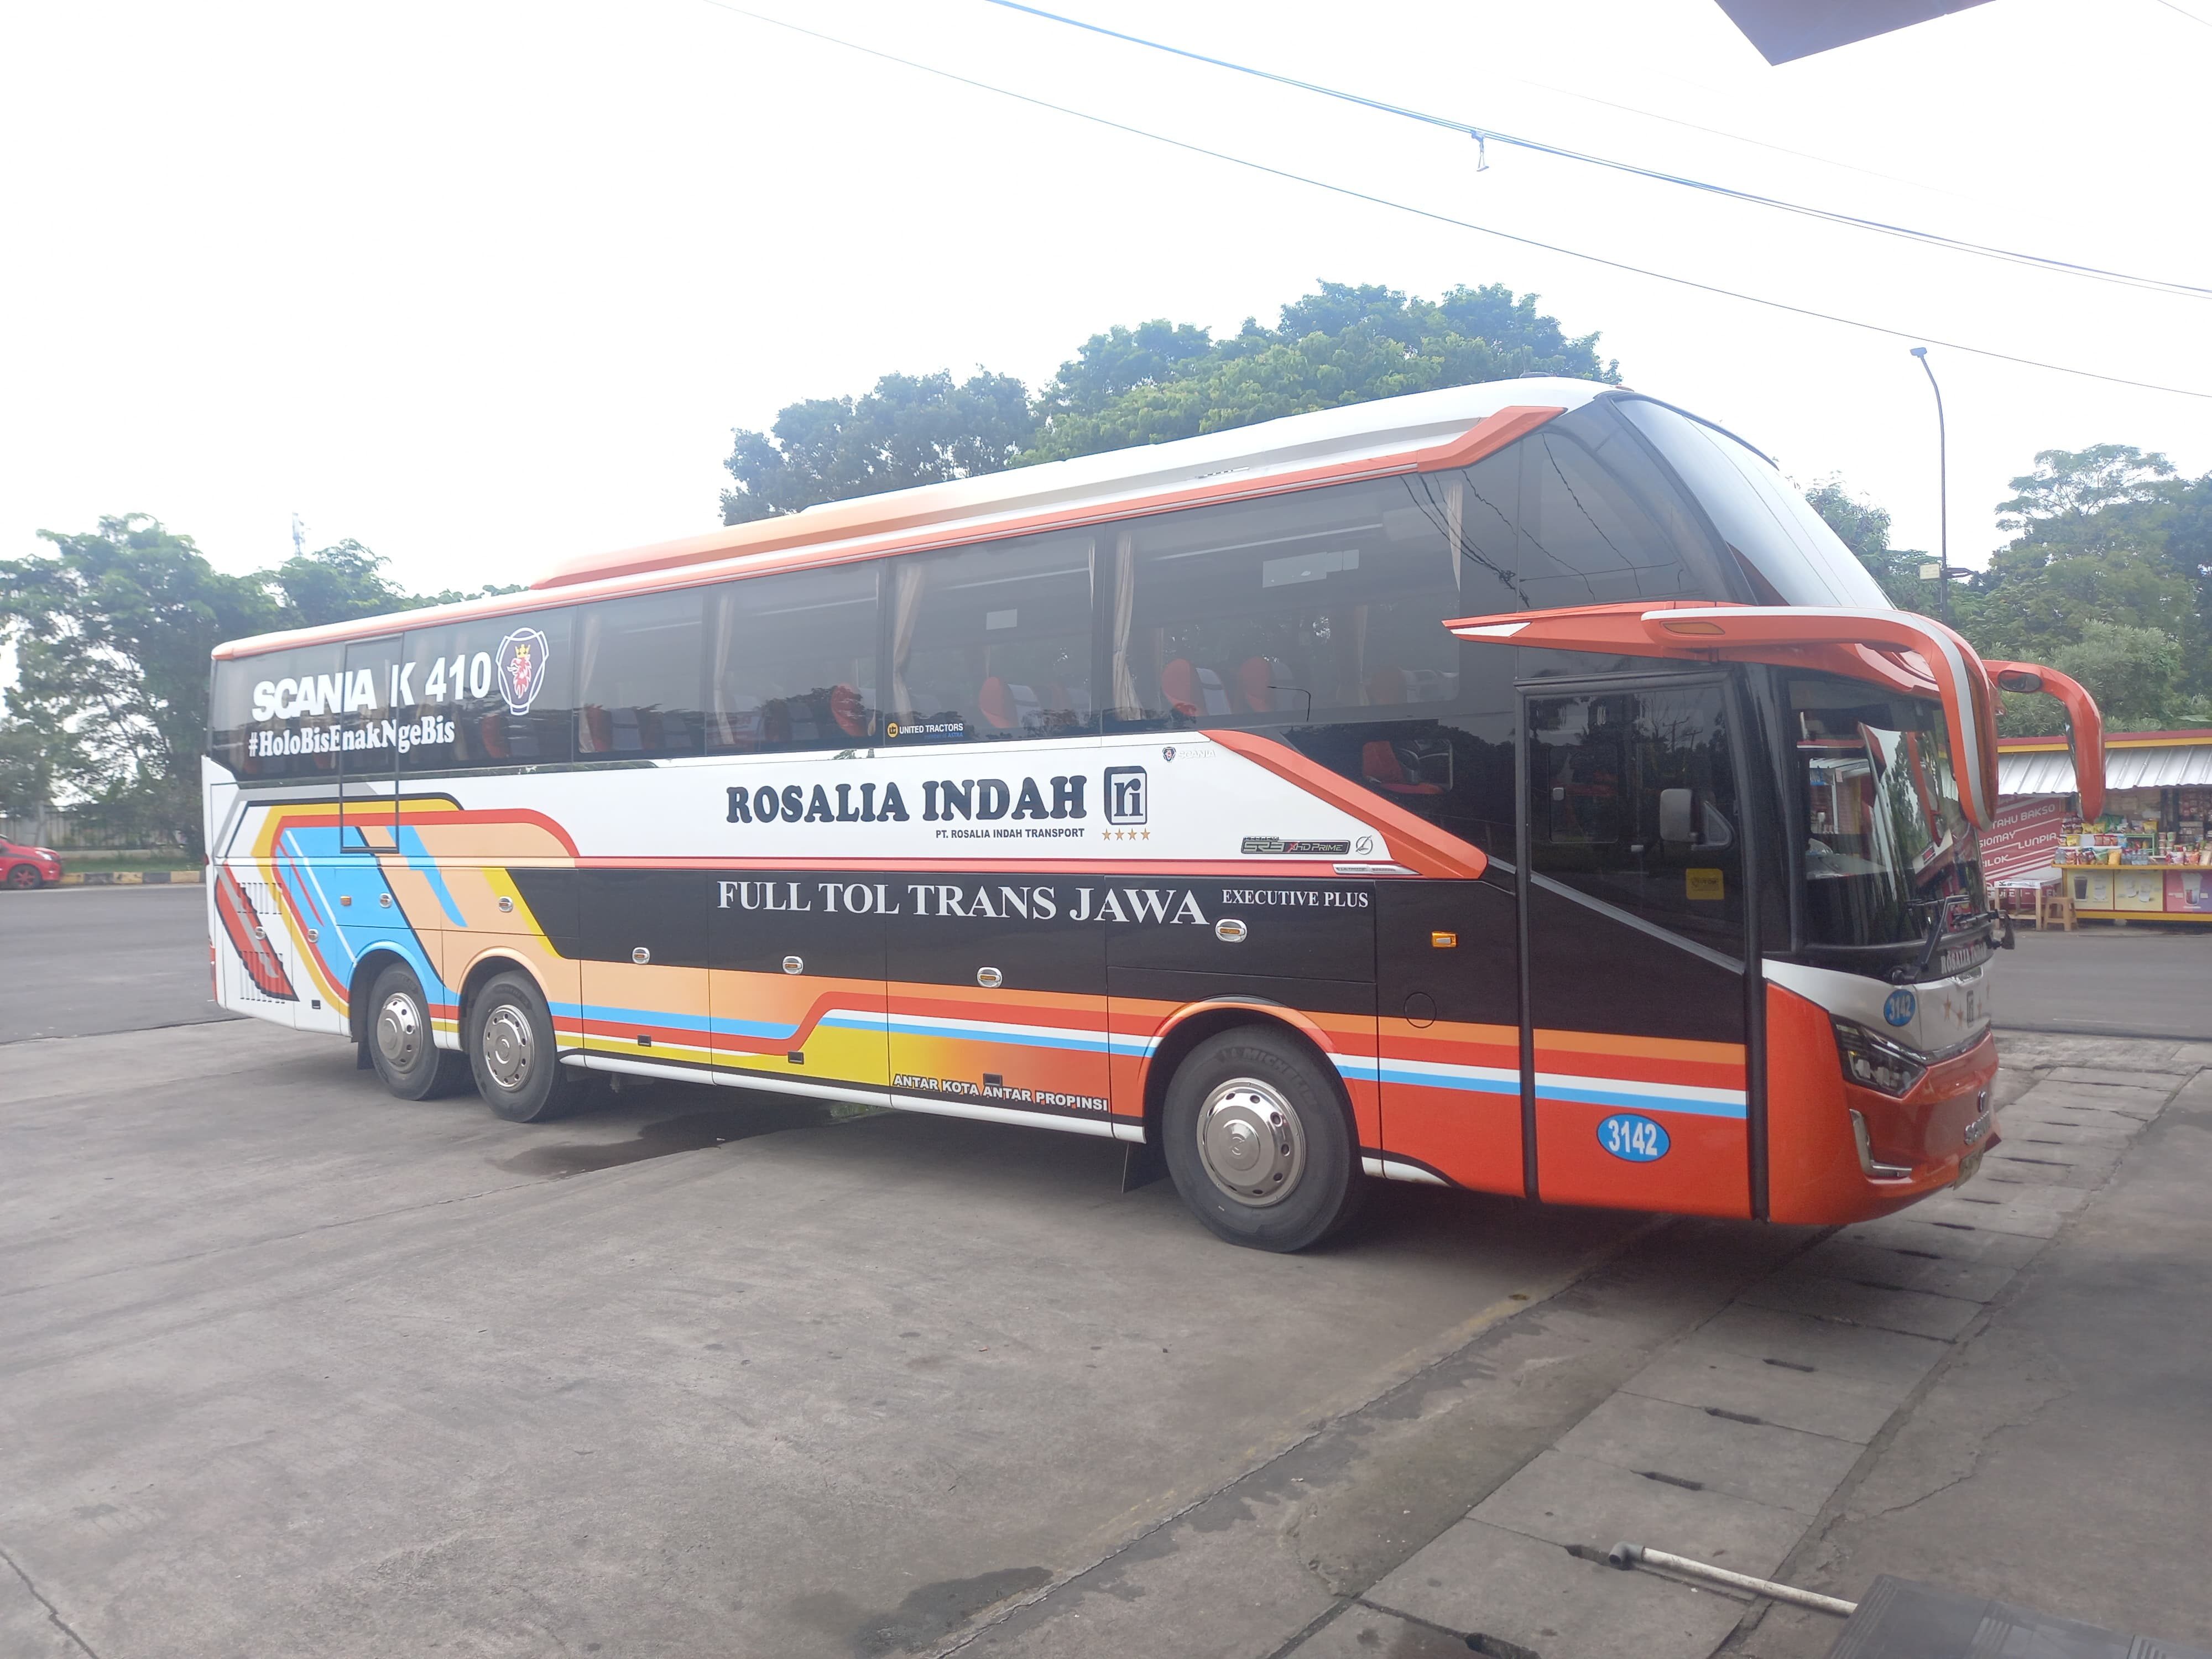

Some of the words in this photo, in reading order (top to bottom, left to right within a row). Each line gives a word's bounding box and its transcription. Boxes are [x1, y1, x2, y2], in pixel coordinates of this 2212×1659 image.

[252, 668, 377, 722] SCANIA
[390, 661, 416, 707] K
[425, 651, 491, 702] 410
[248, 716, 455, 757] #HoloBisEnakNgeBis
[899, 726, 924, 734] UNITED
[925, 723, 963, 733] TRACTORS
[1178, 749, 1217, 759] SCANIA
[727, 782, 909, 823] ROSALIA
[922, 775, 1087, 822] INDAH
[1992, 815, 2018, 830] TAHU
[2021, 804, 2056, 821] BAKSO
[936, 830, 949, 839] PT.
[951, 830, 990, 838] ROSALIA
[993, 829, 1022, 838] INDAH
[1025, 828, 1084, 838] TRANSPORT
[2018, 832, 2057, 849] LUNPIA
[1312, 843, 1343, 852] PRIME
[1982, 854, 2009, 868] ILOK
[717, 881, 811, 912] FULL
[818, 883, 900, 914] TOL
[908, 885, 1056, 920] TRANS
[1069, 888, 1209, 925] JAWA
[1222, 890, 1318, 907] EXECUTIVE
[1323, 891, 1369, 908] PLUS
[1889, 995, 1912, 1020] 3142
[893, 1074, 938, 1091] ANTAR
[941, 1079, 979, 1097] KOTA
[983, 1086, 1031, 1102] ANTAR
[1036, 1092, 1108, 1112] PROPINSI
[1608, 1119, 1658, 1156] 3142
